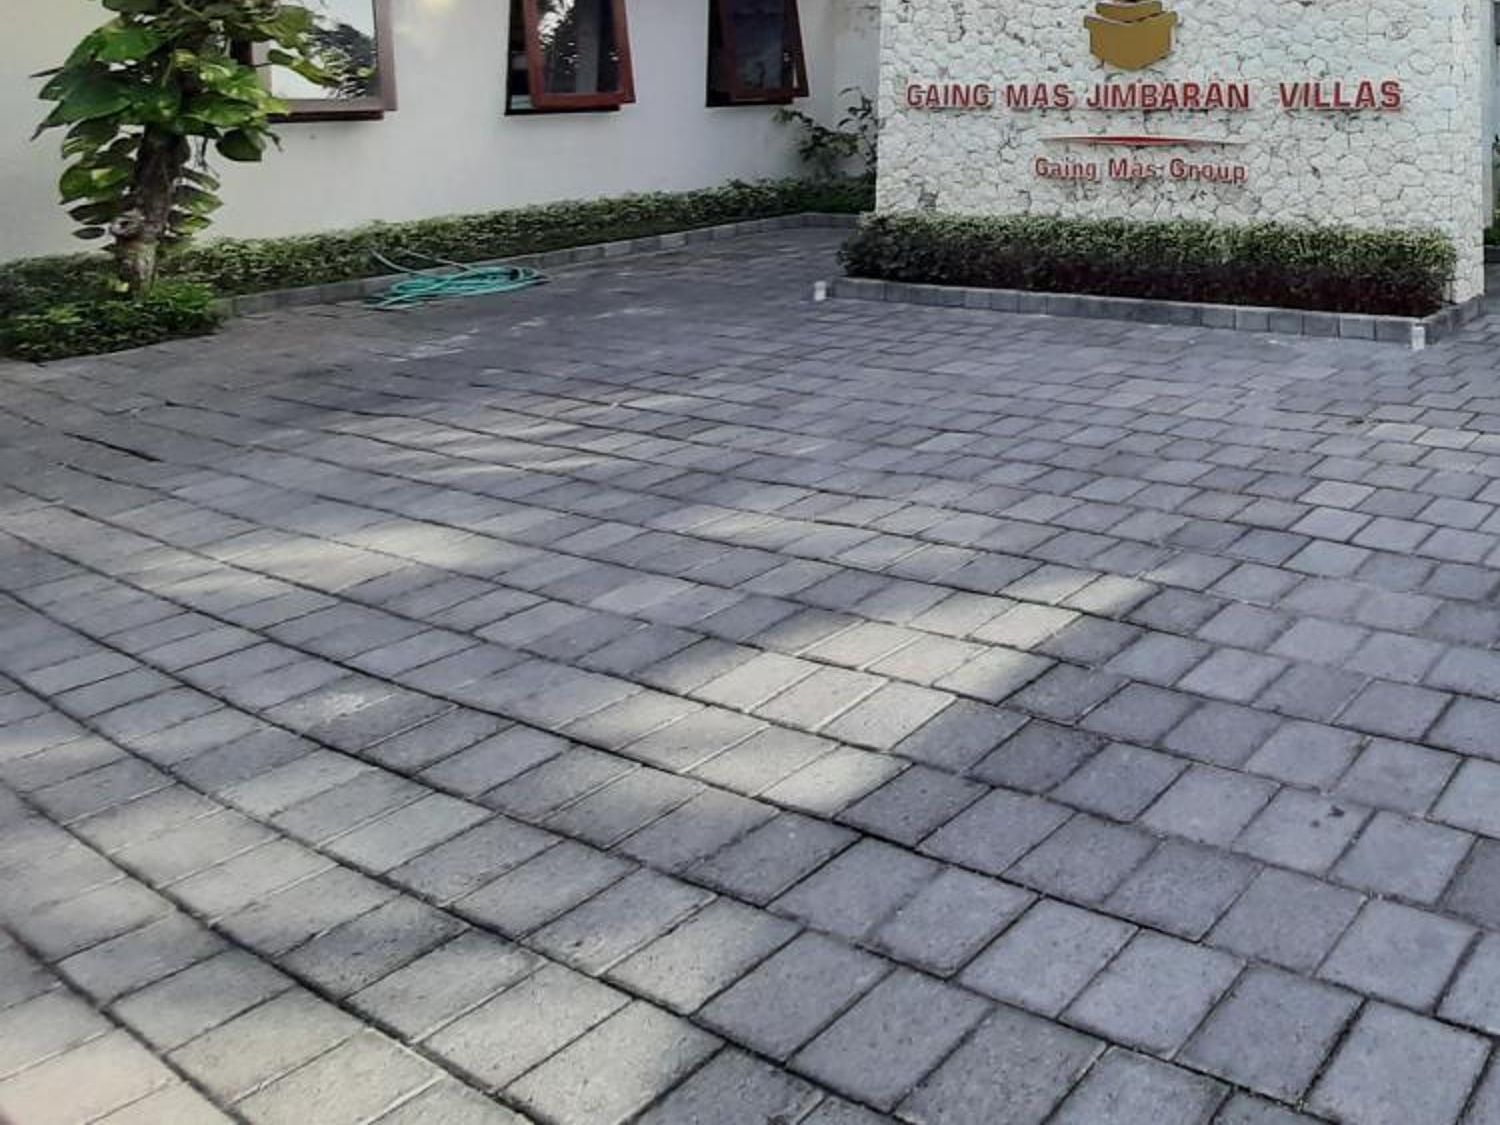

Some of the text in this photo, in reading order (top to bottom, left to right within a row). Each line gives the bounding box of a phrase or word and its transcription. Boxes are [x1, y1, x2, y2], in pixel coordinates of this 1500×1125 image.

[906, 79, 1402, 109] GAING MAS JIMBARAN VILLAS
[1034, 156, 1247, 184] Gaing Mas Group
